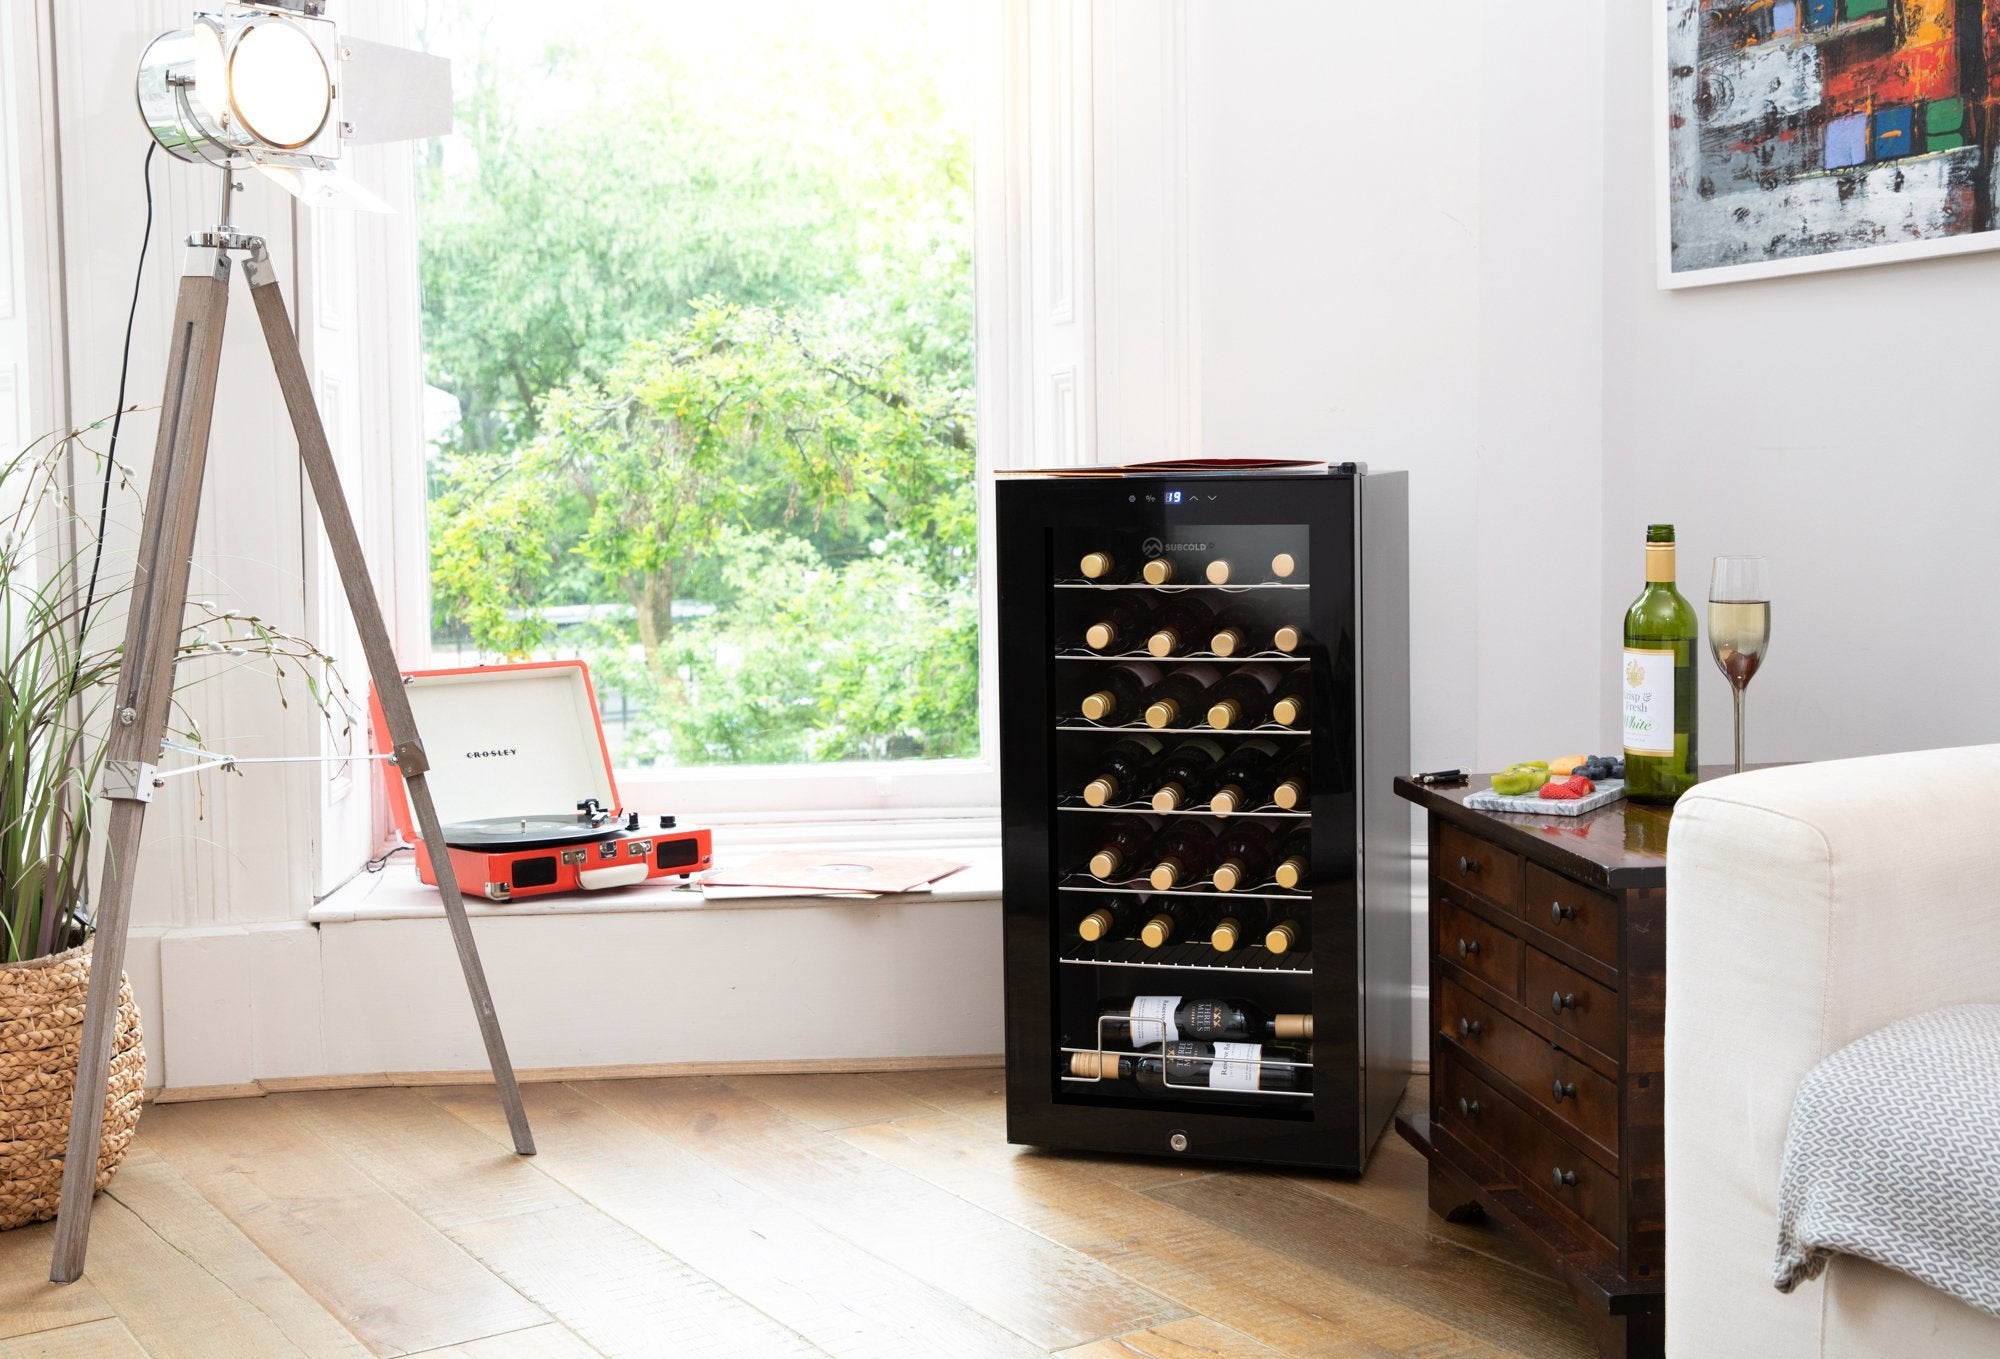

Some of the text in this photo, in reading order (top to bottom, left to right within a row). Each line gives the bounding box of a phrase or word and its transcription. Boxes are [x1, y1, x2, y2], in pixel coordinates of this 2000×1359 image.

[1168, 491, 1182, 503] 19
[1165, 543, 1207, 552] SUBCOLD
[1625, 690, 1652, 703] risp &
[466, 748, 517, 759] CROSLEY
[1184, 1042, 1194, 1067] MLLS
